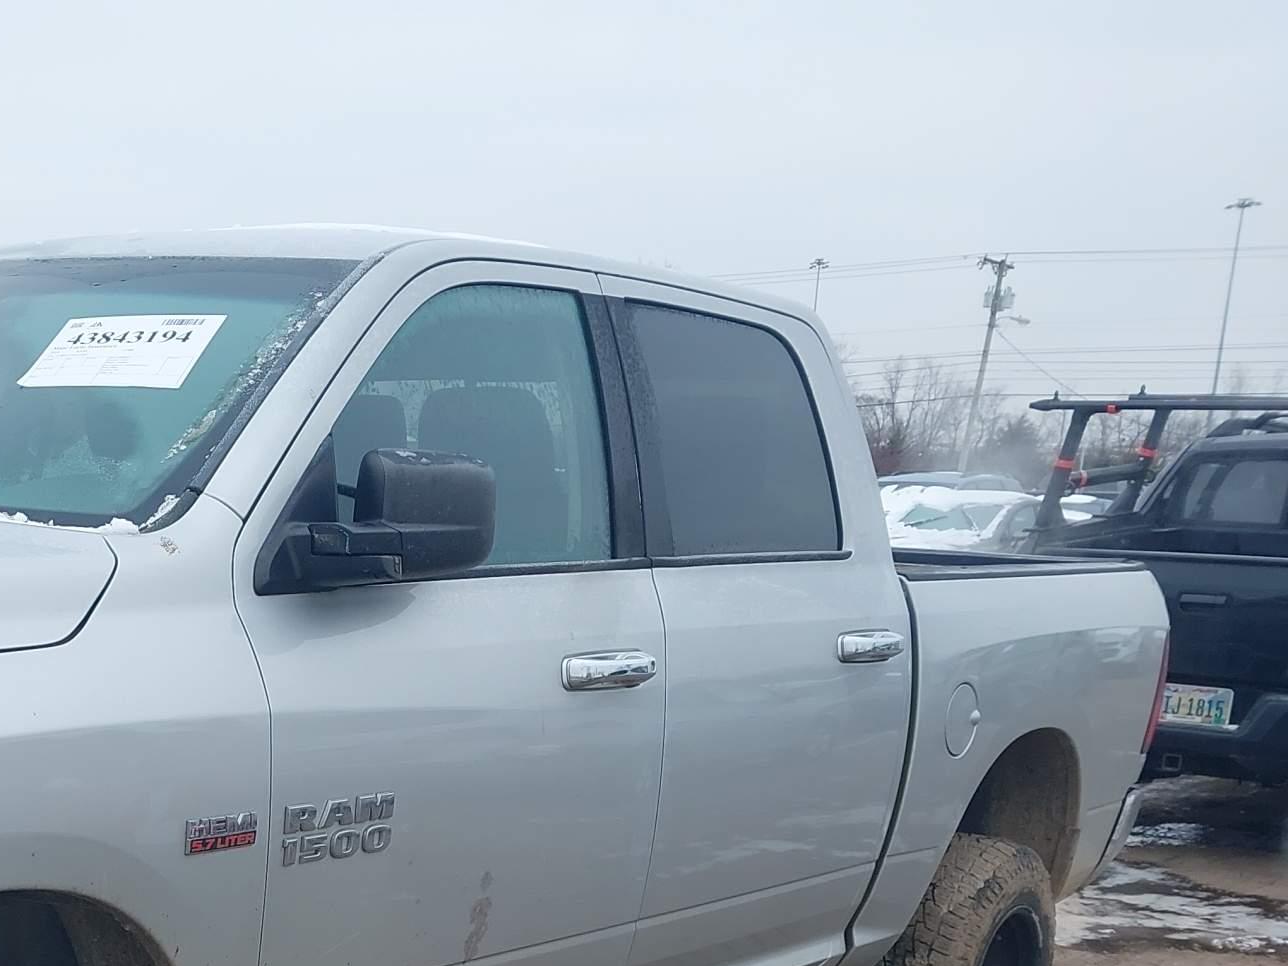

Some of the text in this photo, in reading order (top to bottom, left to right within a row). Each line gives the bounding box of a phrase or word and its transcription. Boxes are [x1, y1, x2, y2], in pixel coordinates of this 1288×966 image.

[67, 329, 193, 345] 43843194
[1186, 697, 1225, 719] 1815
[186, 811, 258, 838] HEMI
[283, 792, 395, 834] RAM
[191, 832, 255, 853] 5.7 LITER
[282, 824, 393, 867] 1500
